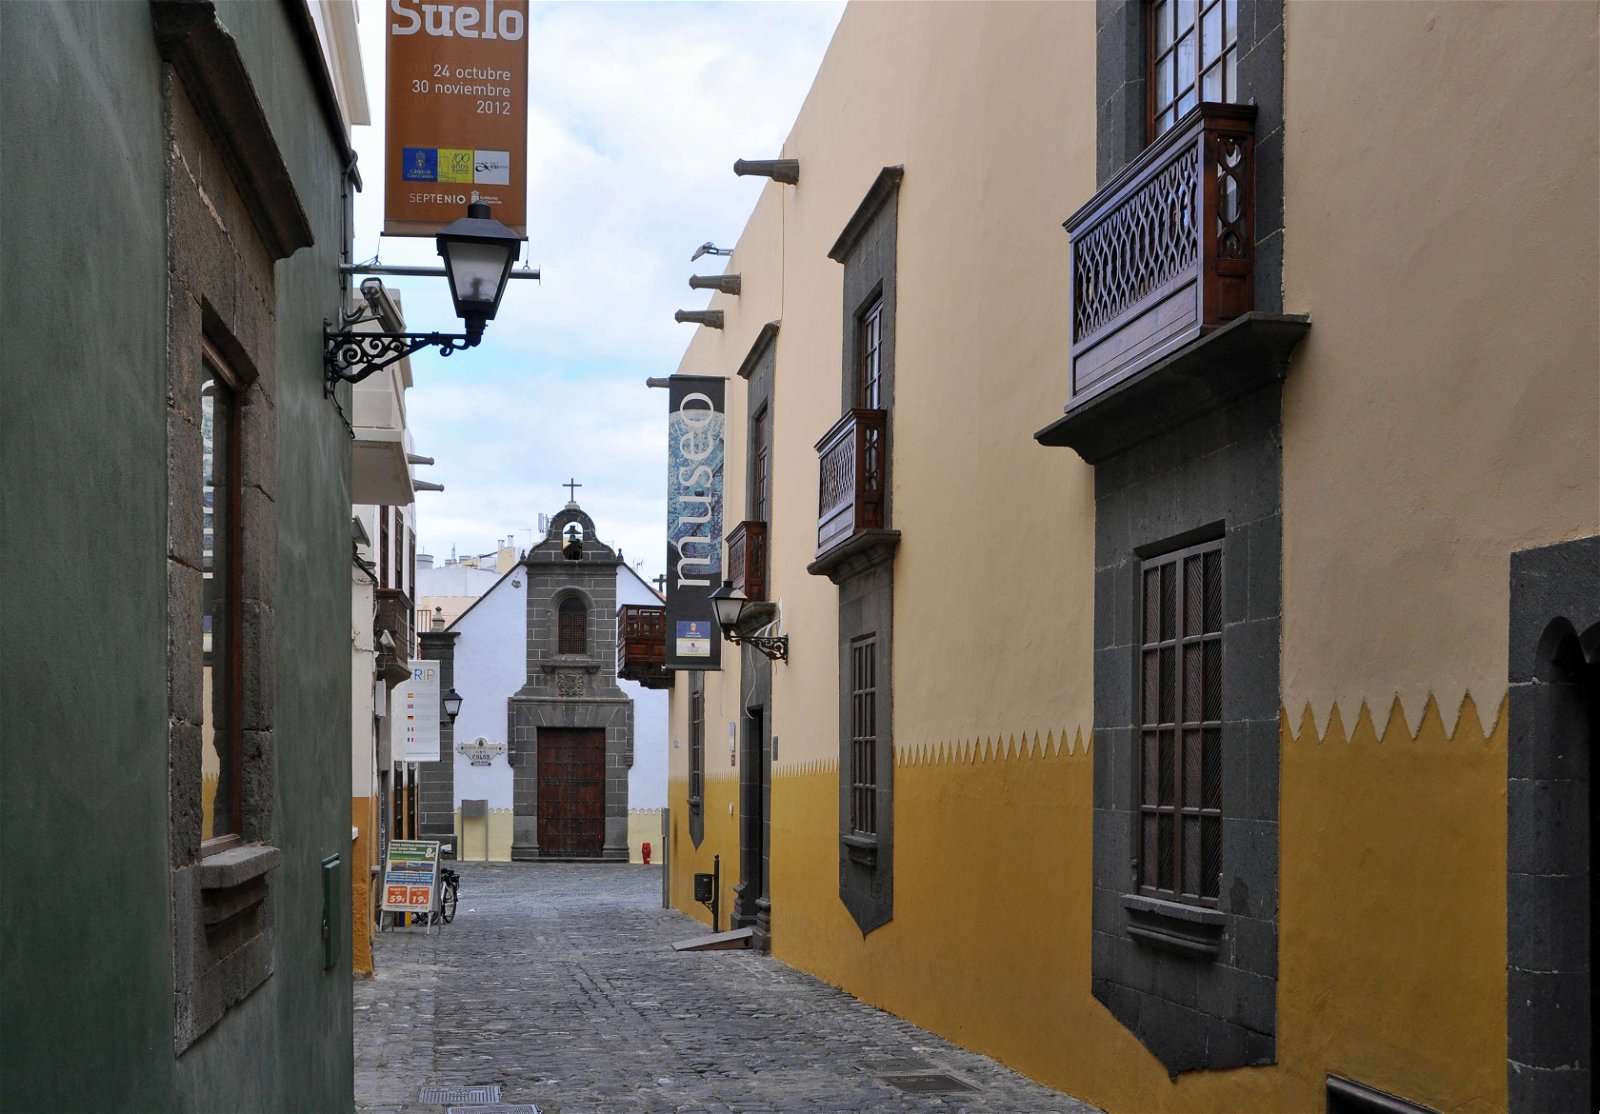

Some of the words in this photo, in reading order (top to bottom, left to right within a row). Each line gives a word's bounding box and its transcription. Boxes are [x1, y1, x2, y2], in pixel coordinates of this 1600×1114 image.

[391, 0, 524, 41] Suelo
[433, 64, 450, 77] 24
[455, 66, 511, 81] octubre
[411, 79, 429, 93] 30
[435, 81, 511, 97] noviembre
[476, 100, 511, 115] 2012
[408, 192, 466, 204] SEPTENIO
[677, 392, 714, 590] museo
